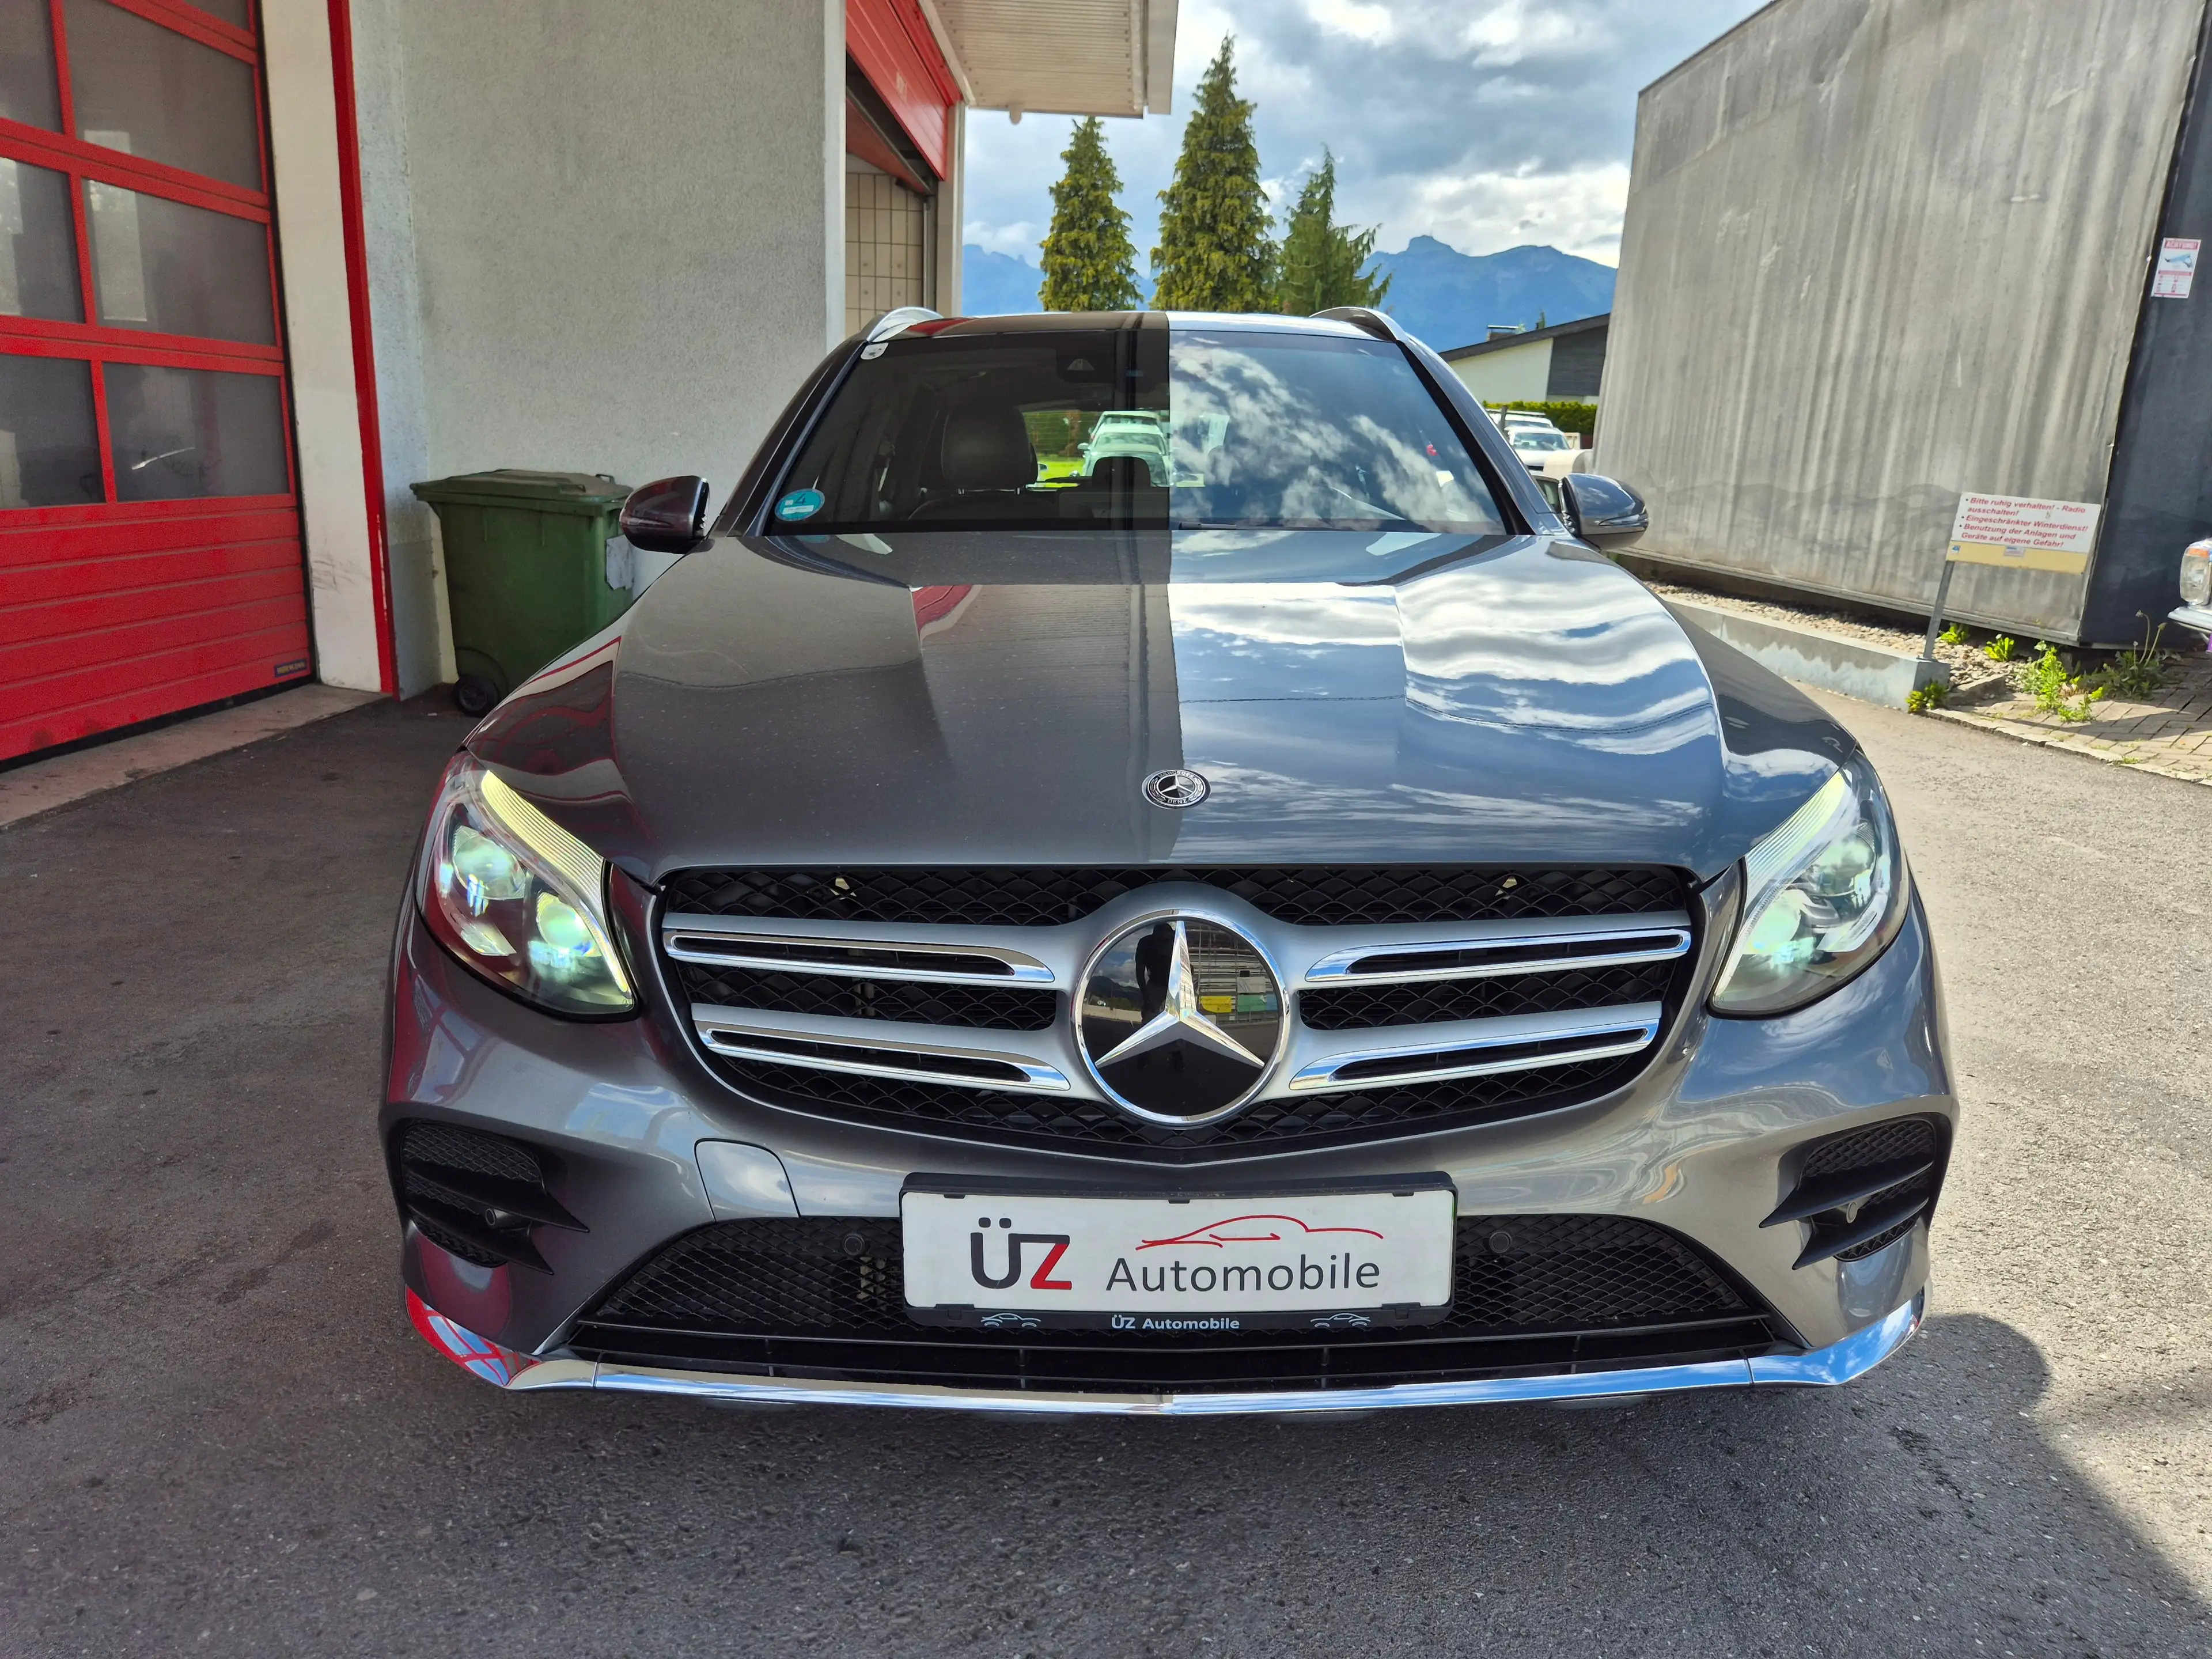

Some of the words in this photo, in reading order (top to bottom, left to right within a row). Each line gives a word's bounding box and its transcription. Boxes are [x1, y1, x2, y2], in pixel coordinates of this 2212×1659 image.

[794, 493, 806, 505] 4
[1968, 507, 2019, 516] ausschalten!
[2014, 502, 2055, 510] verhalten!
[2062, 505, 2085, 513] Radio
[1966, 515, 2031, 527] Eingeschränkter
[2033, 521, 2088, 531] Winterdienst!
[1964, 523, 2006, 534] Benutzung
[2024, 529, 2057, 538] Anlagen
[2004, 536, 2031, 544] eigene
[2033, 539, 2064, 547] Gefahr!
[971, 1217, 1072, 1290] ÜZ
[1105, 1252, 1380, 1292] Automobile
[1112, 1314, 1136, 1329] ÜZ
[1142, 1317, 1240, 1329] Automobile
